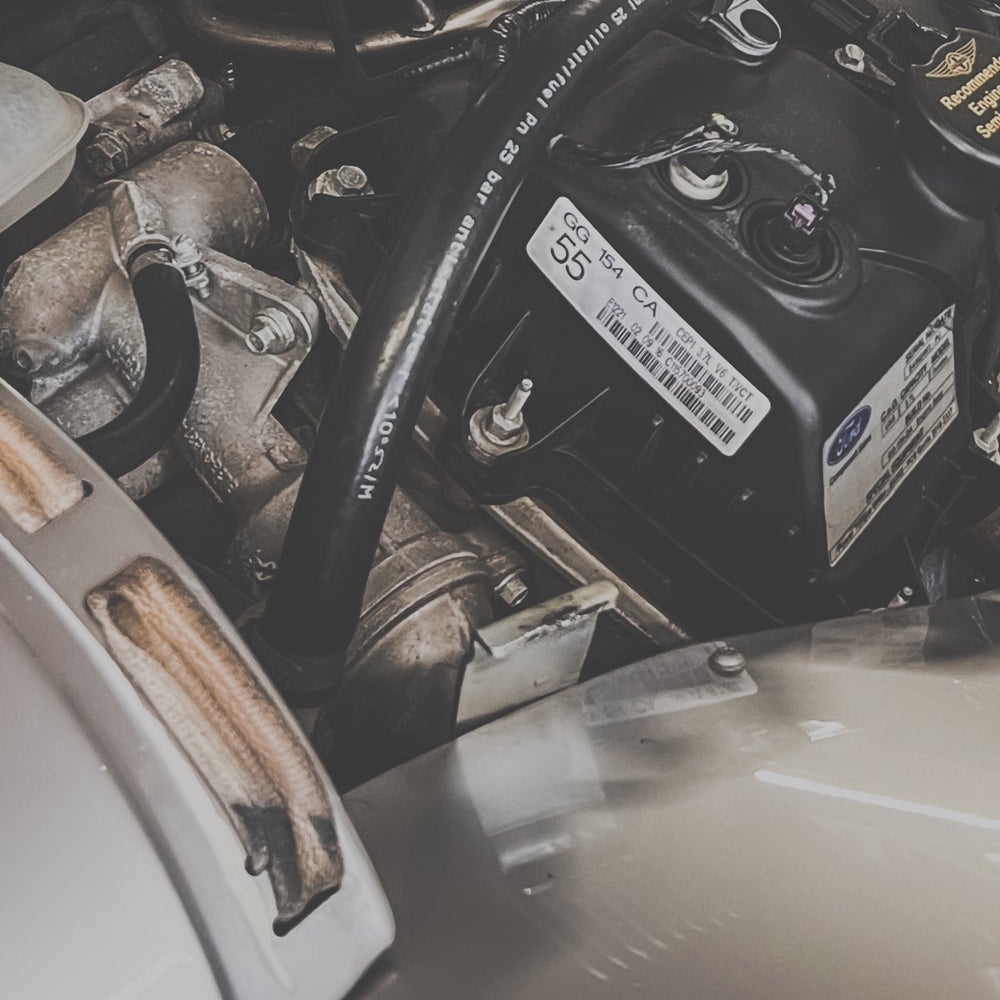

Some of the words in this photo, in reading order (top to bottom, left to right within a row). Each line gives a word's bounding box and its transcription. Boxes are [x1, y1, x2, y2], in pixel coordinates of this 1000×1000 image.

[610, 6, 628, 26] 25
[498, 139, 520, 165] 25
[476, 169, 503, 206] bar
[550, 232, 592, 281] 55
[563, 211, 591, 245] GG
[598, 248, 624, 279] 154
[632, 285, 658, 318] CA
[630, 322, 643, 336] 02
[714, 362, 728, 378] V6
